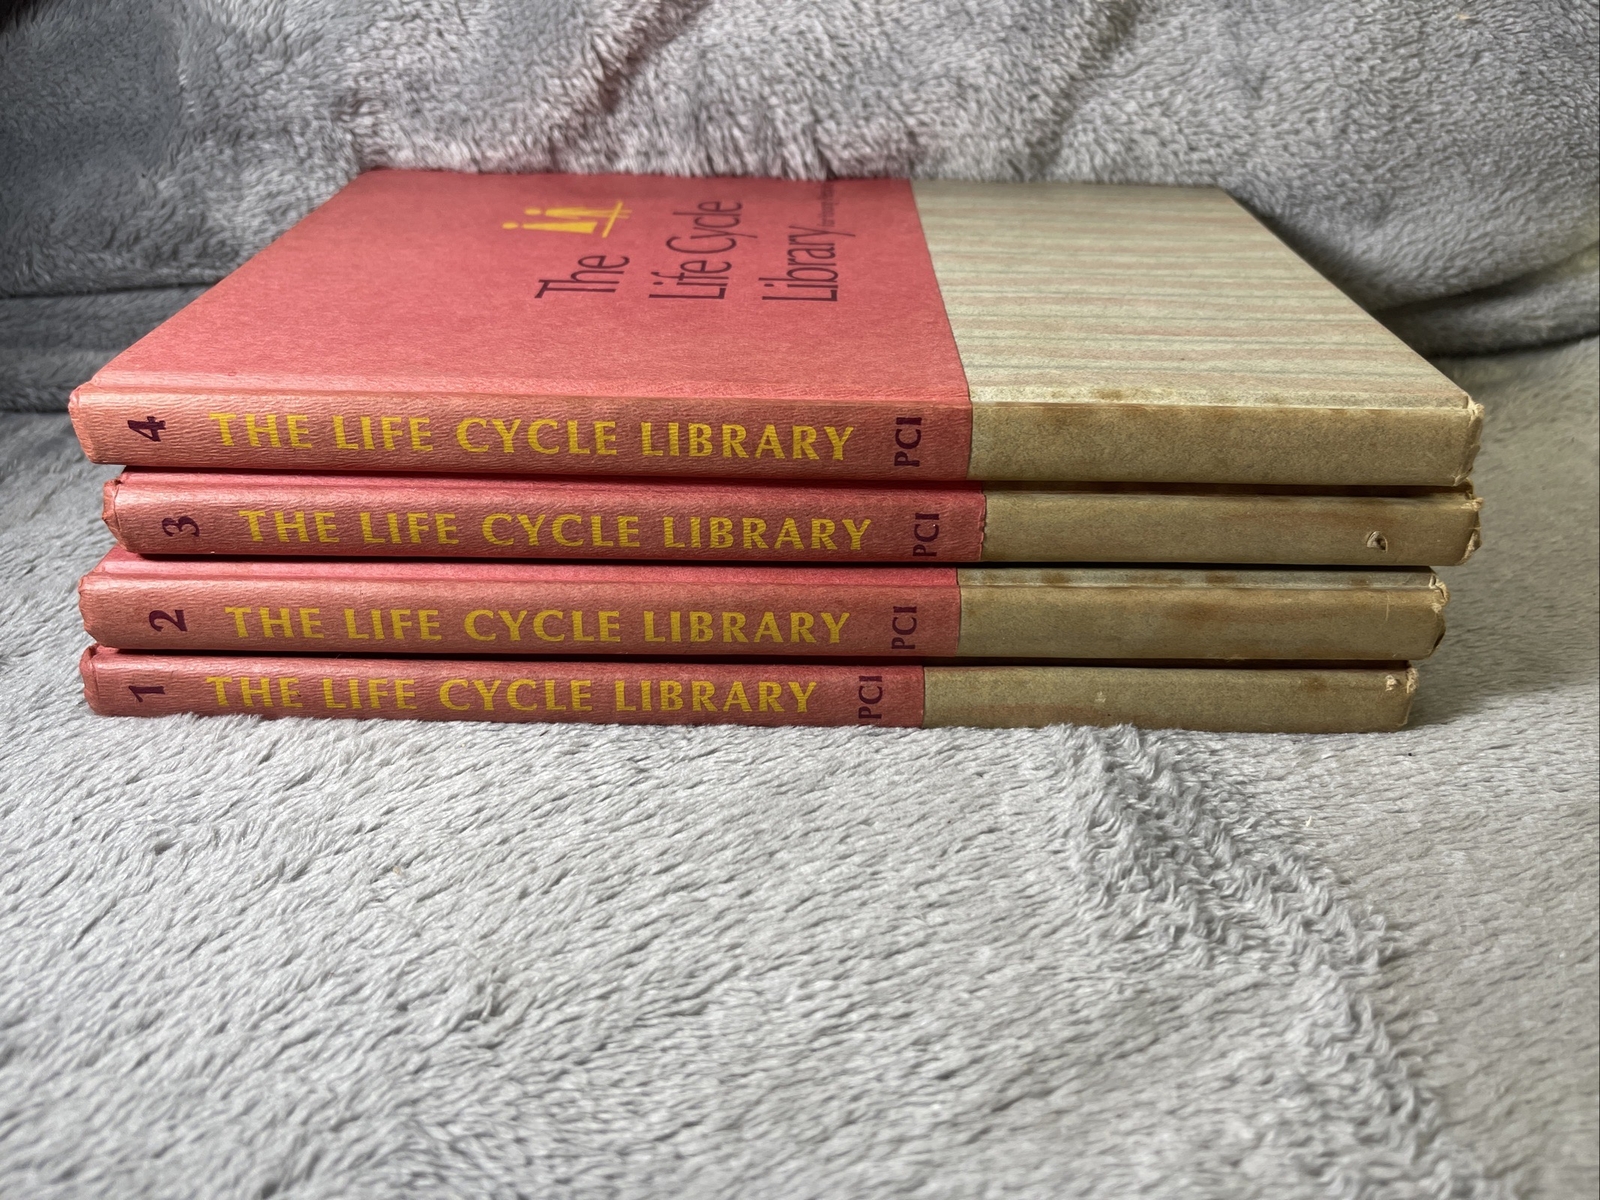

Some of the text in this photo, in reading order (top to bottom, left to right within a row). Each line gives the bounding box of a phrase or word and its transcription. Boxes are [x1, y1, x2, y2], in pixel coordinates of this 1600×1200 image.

[648, 200, 759, 300] Life Cycle
[758, 225, 857, 302] Library
[534, 254, 630, 299] The
[127, 415, 167, 443] 4
[209, 412, 854, 460] THE LIFE CYCLE LIBRARY
[894, 416, 922, 467] PCI
[161, 514, 200, 538] 3
[239, 510, 872, 550] THE LIFE CYCLE LIBRARY
[912, 512, 940, 557] PCI
[148, 608, 188, 632] 2
[225, 607, 850, 644] THE LIFE CYCLE LIBRARY
[891, 606, 918, 650] PCI
[128, 685, 166, 703] 1
[206, 677, 818, 713] THE LIFE CYCLE LIBRARY
[859, 675, 883, 719] PCI
